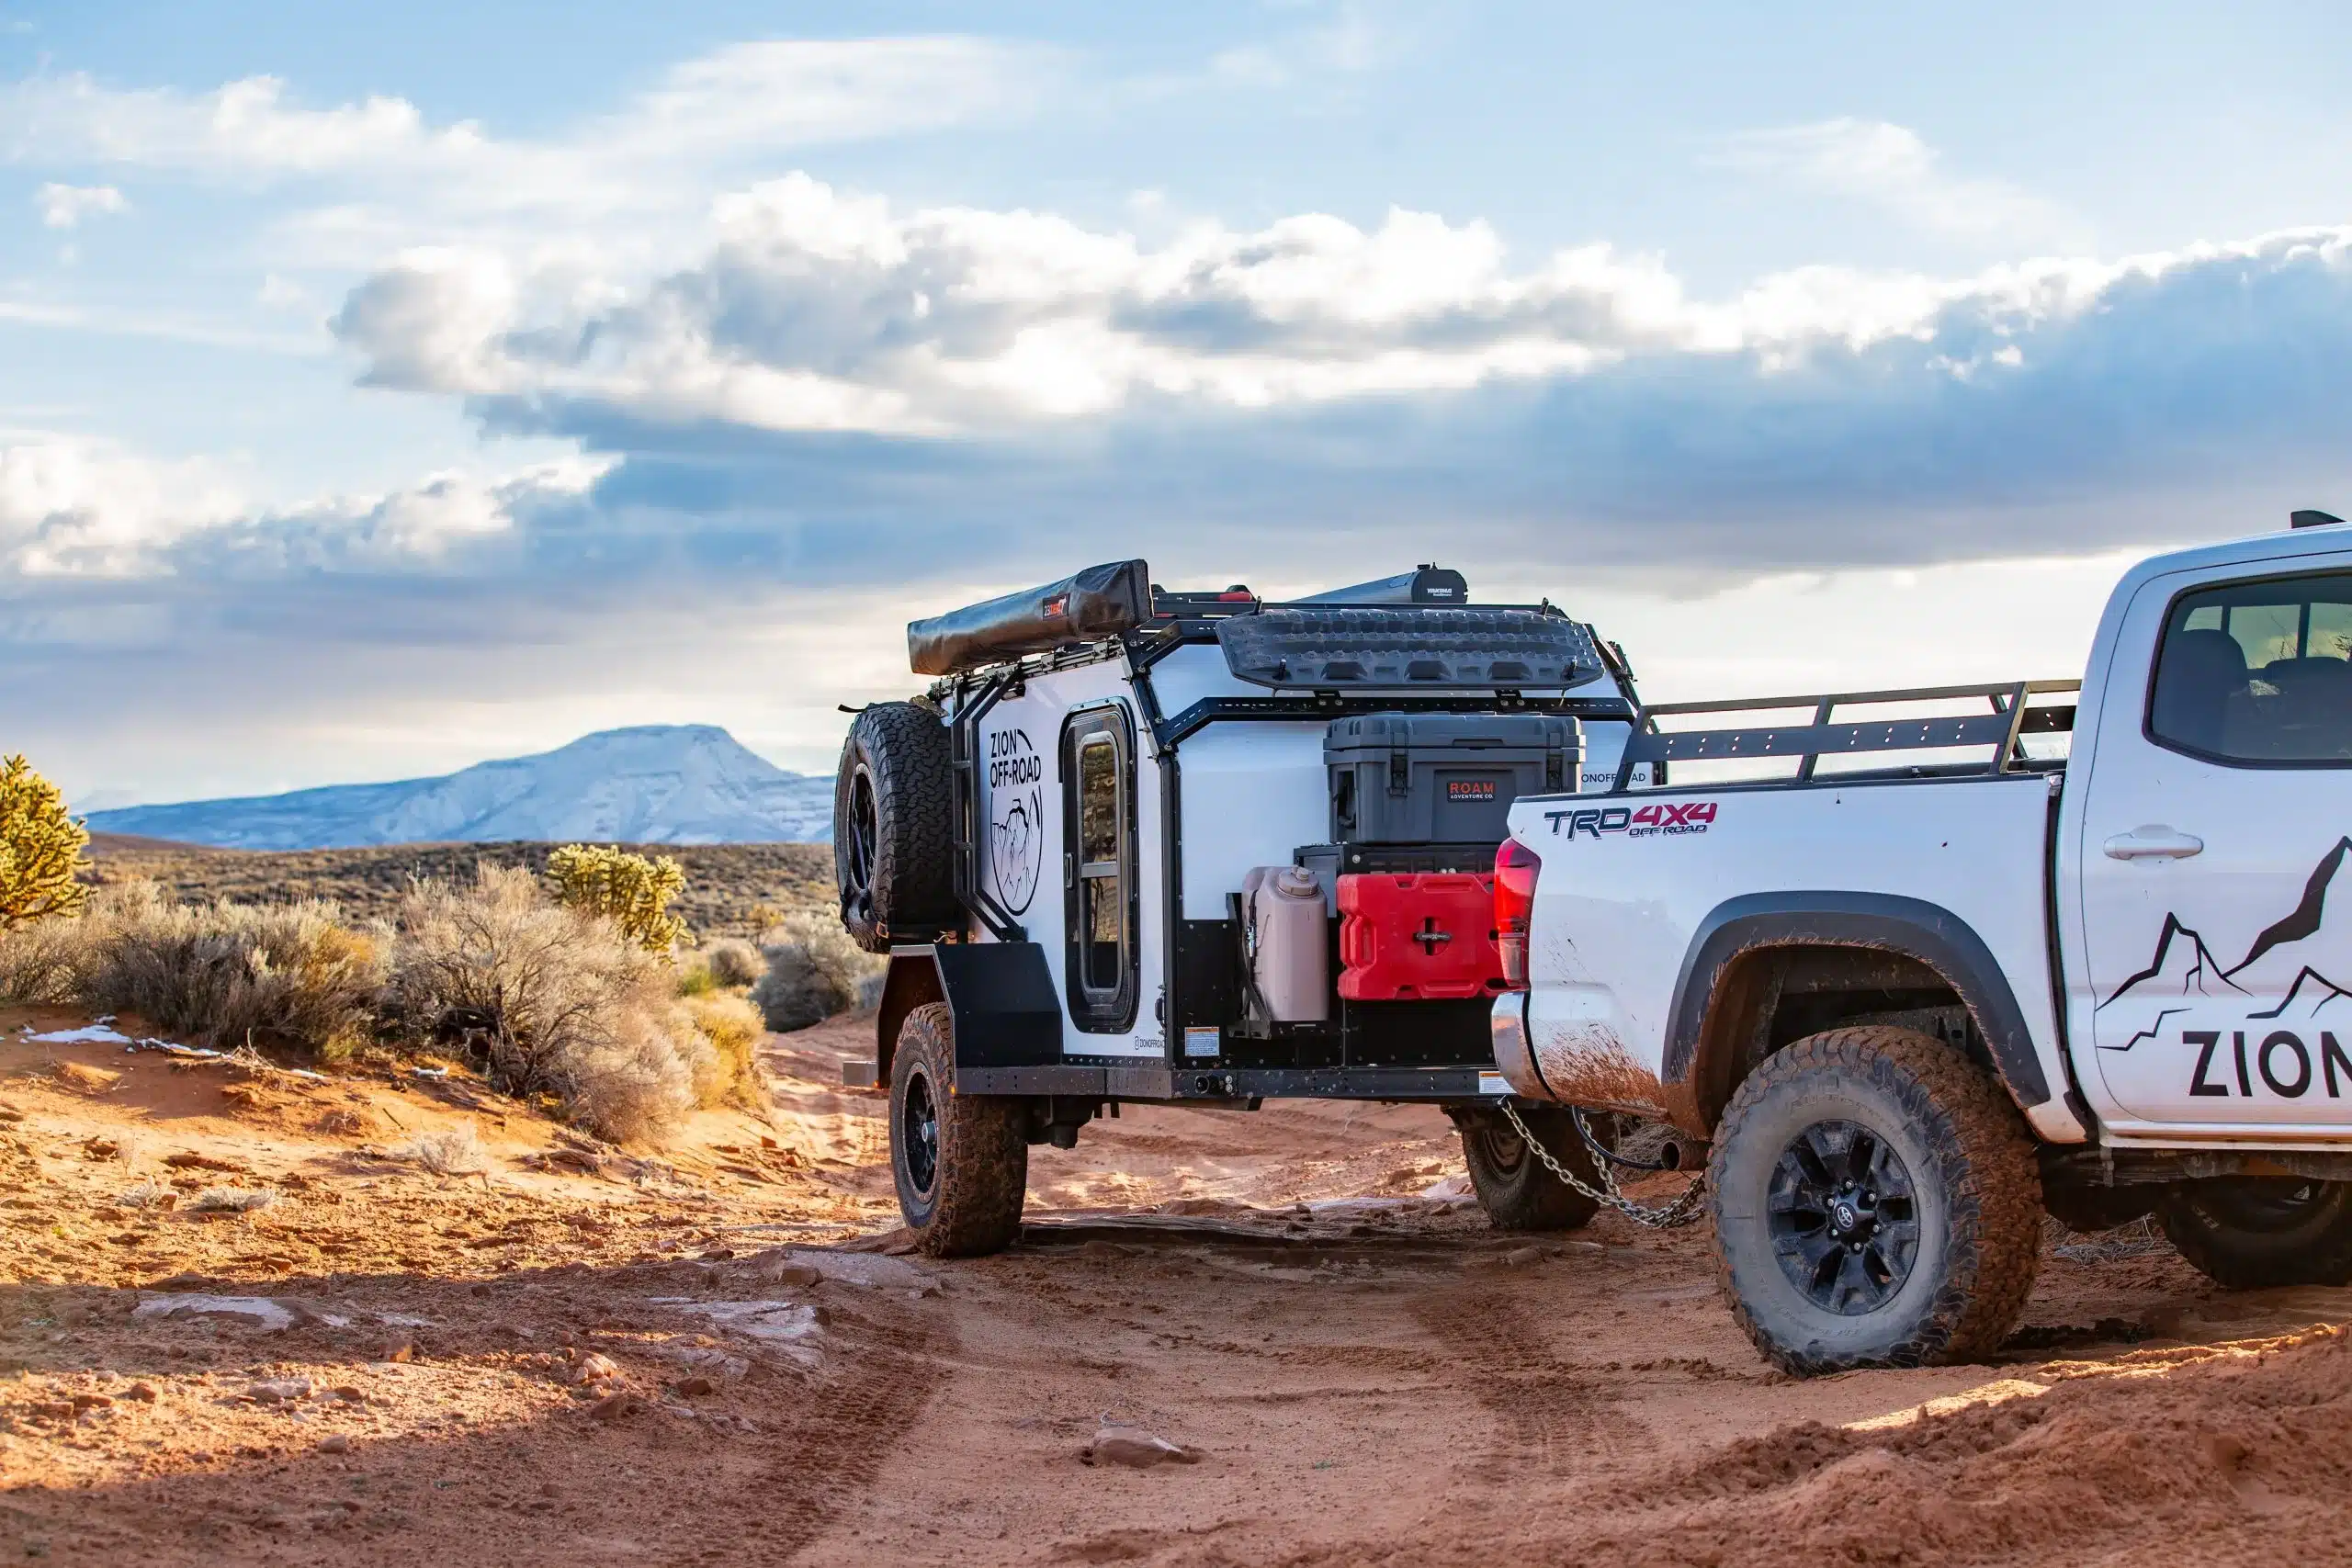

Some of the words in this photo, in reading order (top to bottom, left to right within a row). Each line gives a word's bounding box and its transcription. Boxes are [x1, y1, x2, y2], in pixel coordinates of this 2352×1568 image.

[990, 728, 1017, 758] ZION
[989, 755, 1041, 788] OFF-ROAD
[1580, 773, 1646, 783] ONOFFAD
[1450, 782, 1494, 794] ROAM
[1629, 827, 1662, 839] OFF
[1662, 824, 1708, 837] ROAD
